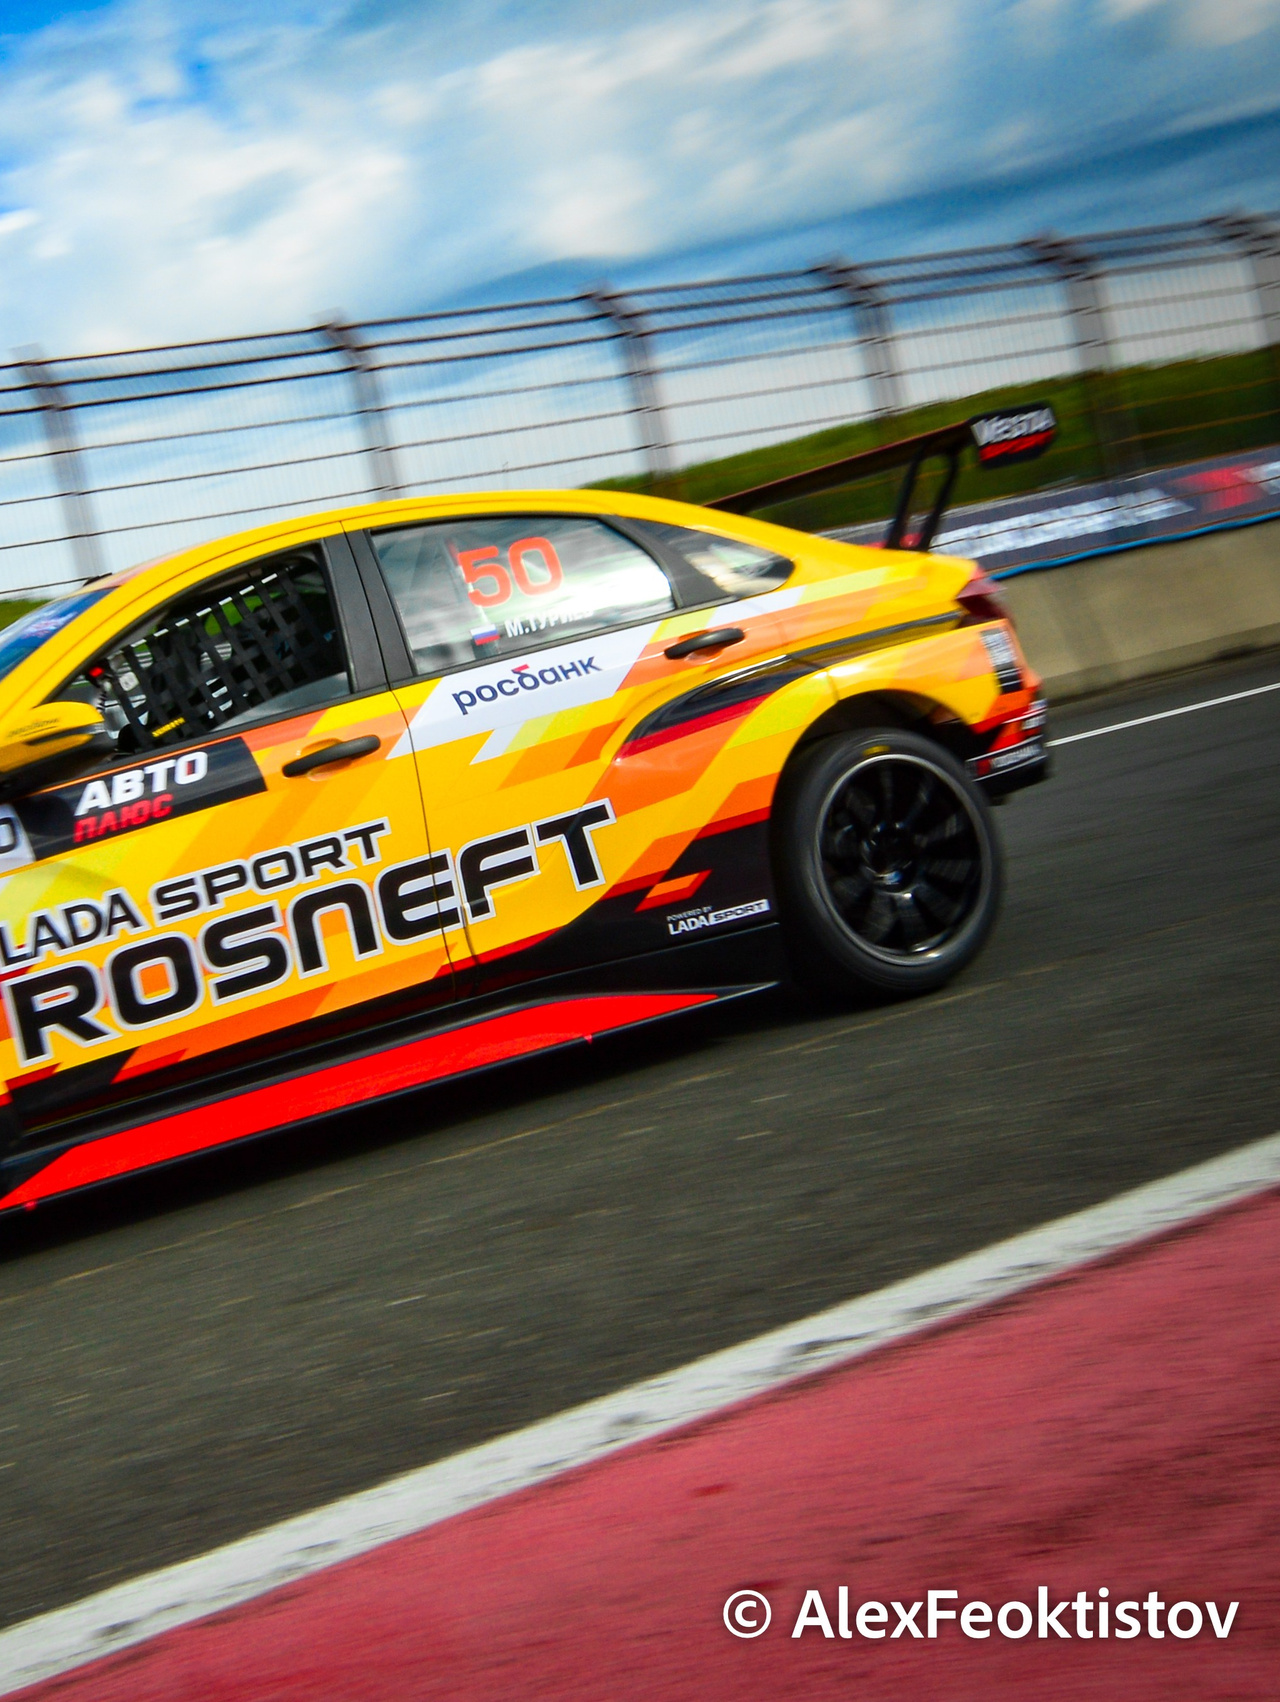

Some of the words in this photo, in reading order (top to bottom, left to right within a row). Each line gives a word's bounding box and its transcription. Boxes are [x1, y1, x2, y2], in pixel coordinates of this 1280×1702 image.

[457, 536, 563, 608] 50
[504, 607, 596, 638] М.ТУРИ
[451, 656, 603, 716] росбанк
[74, 751, 209, 817] АВТО
[73, 793, 175, 844] ПЛЮС
[152, 818, 390, 926] SPORT
[1, 798, 616, 1067] ROSNEFT
[668, 916, 710, 936] LADA
[713, 901, 765, 923] SPORT
